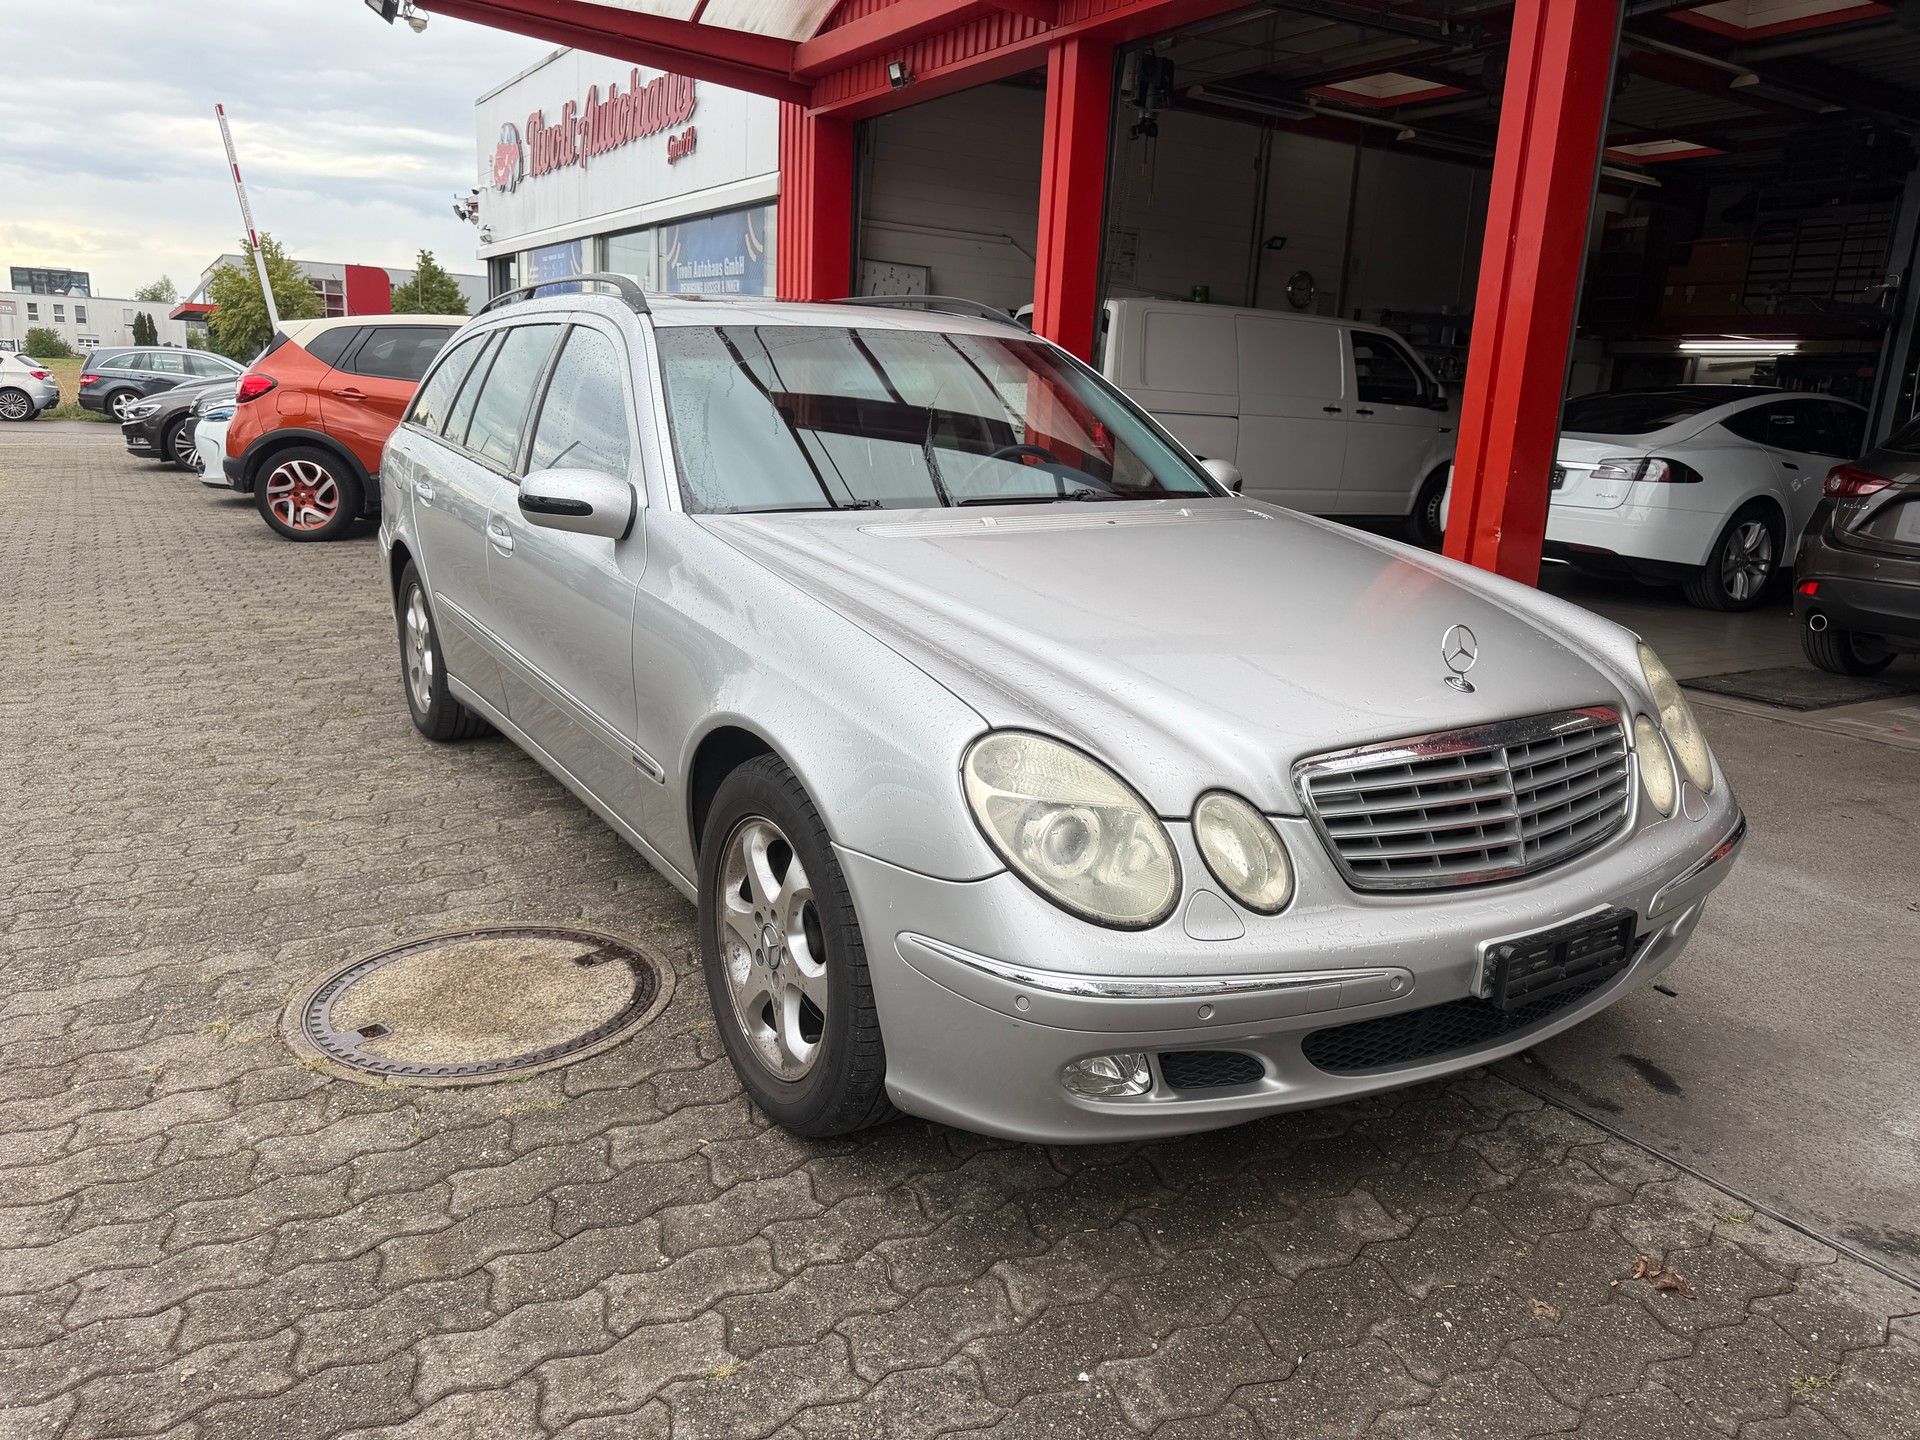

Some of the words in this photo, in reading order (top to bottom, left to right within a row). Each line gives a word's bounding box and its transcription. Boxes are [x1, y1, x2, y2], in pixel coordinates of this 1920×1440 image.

[526, 100, 578, 177] Tivoli
[577, 68, 697, 169] Autohaus
[667, 126, 697, 165] GmbH
[676, 262, 693, 279] Tivoli
[693, 259, 723, 278] Autohaus
[724, 256, 745, 276] GmbH
